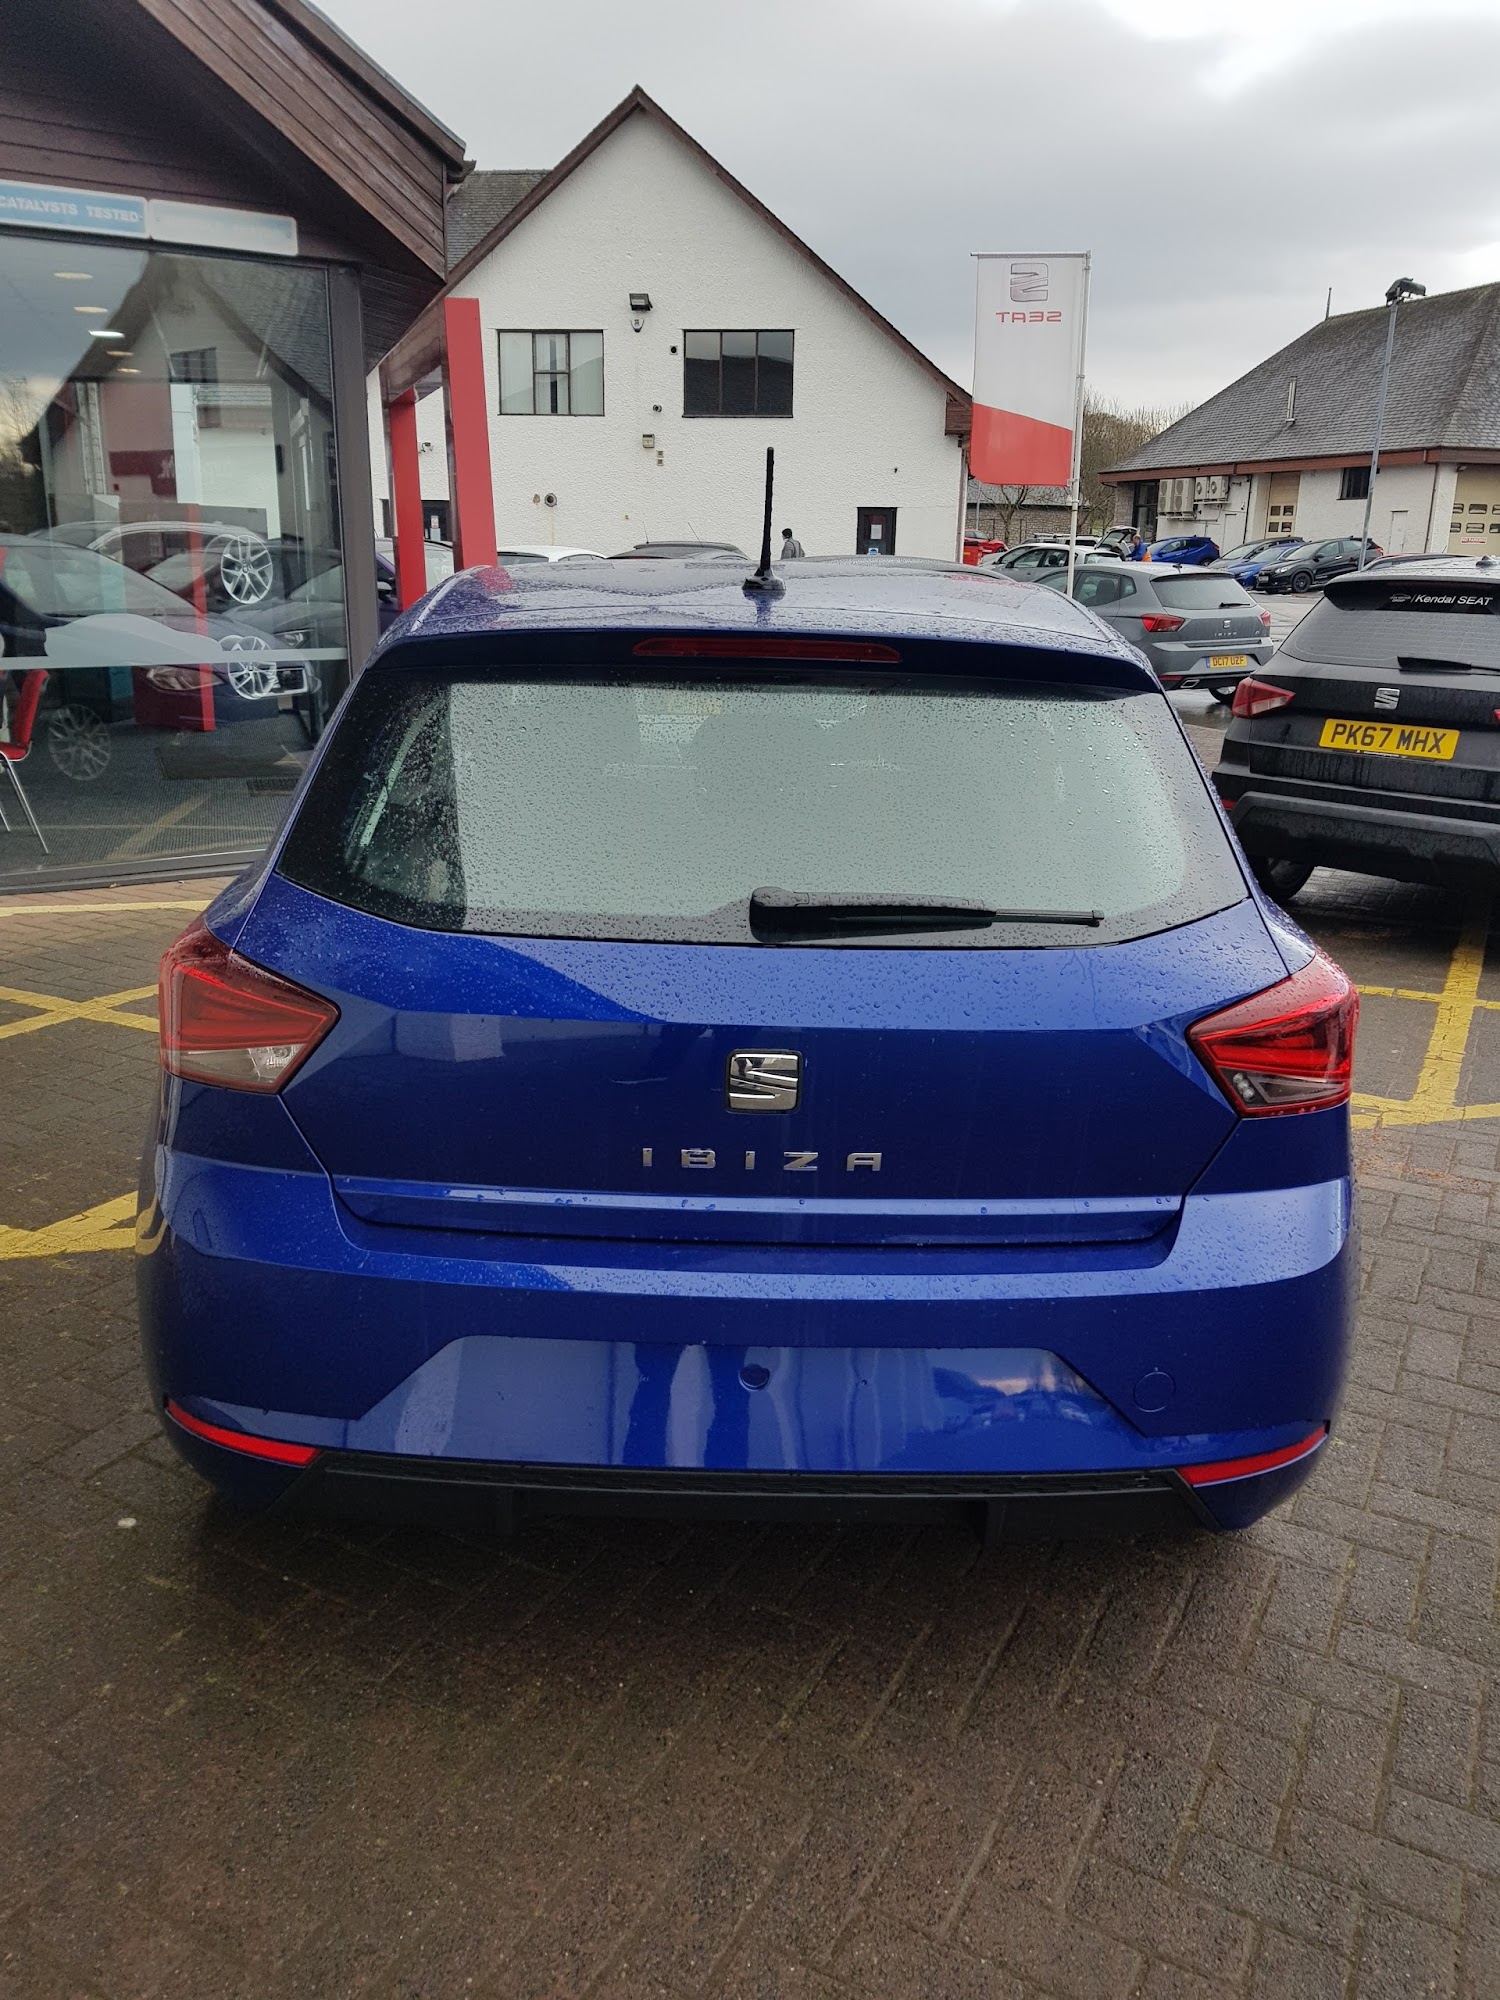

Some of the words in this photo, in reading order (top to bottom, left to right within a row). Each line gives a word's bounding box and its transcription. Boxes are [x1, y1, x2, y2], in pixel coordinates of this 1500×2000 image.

[1414, 594, 1457, 605] Kendal
[1457, 595, 1493, 606] SEAT
[1212, 656, 1229, 667] DC17
[1330, 723, 1393, 748] PK67
[1395, 729, 1447, 754] MHX
[642, 1147, 883, 1172] IBIZA
